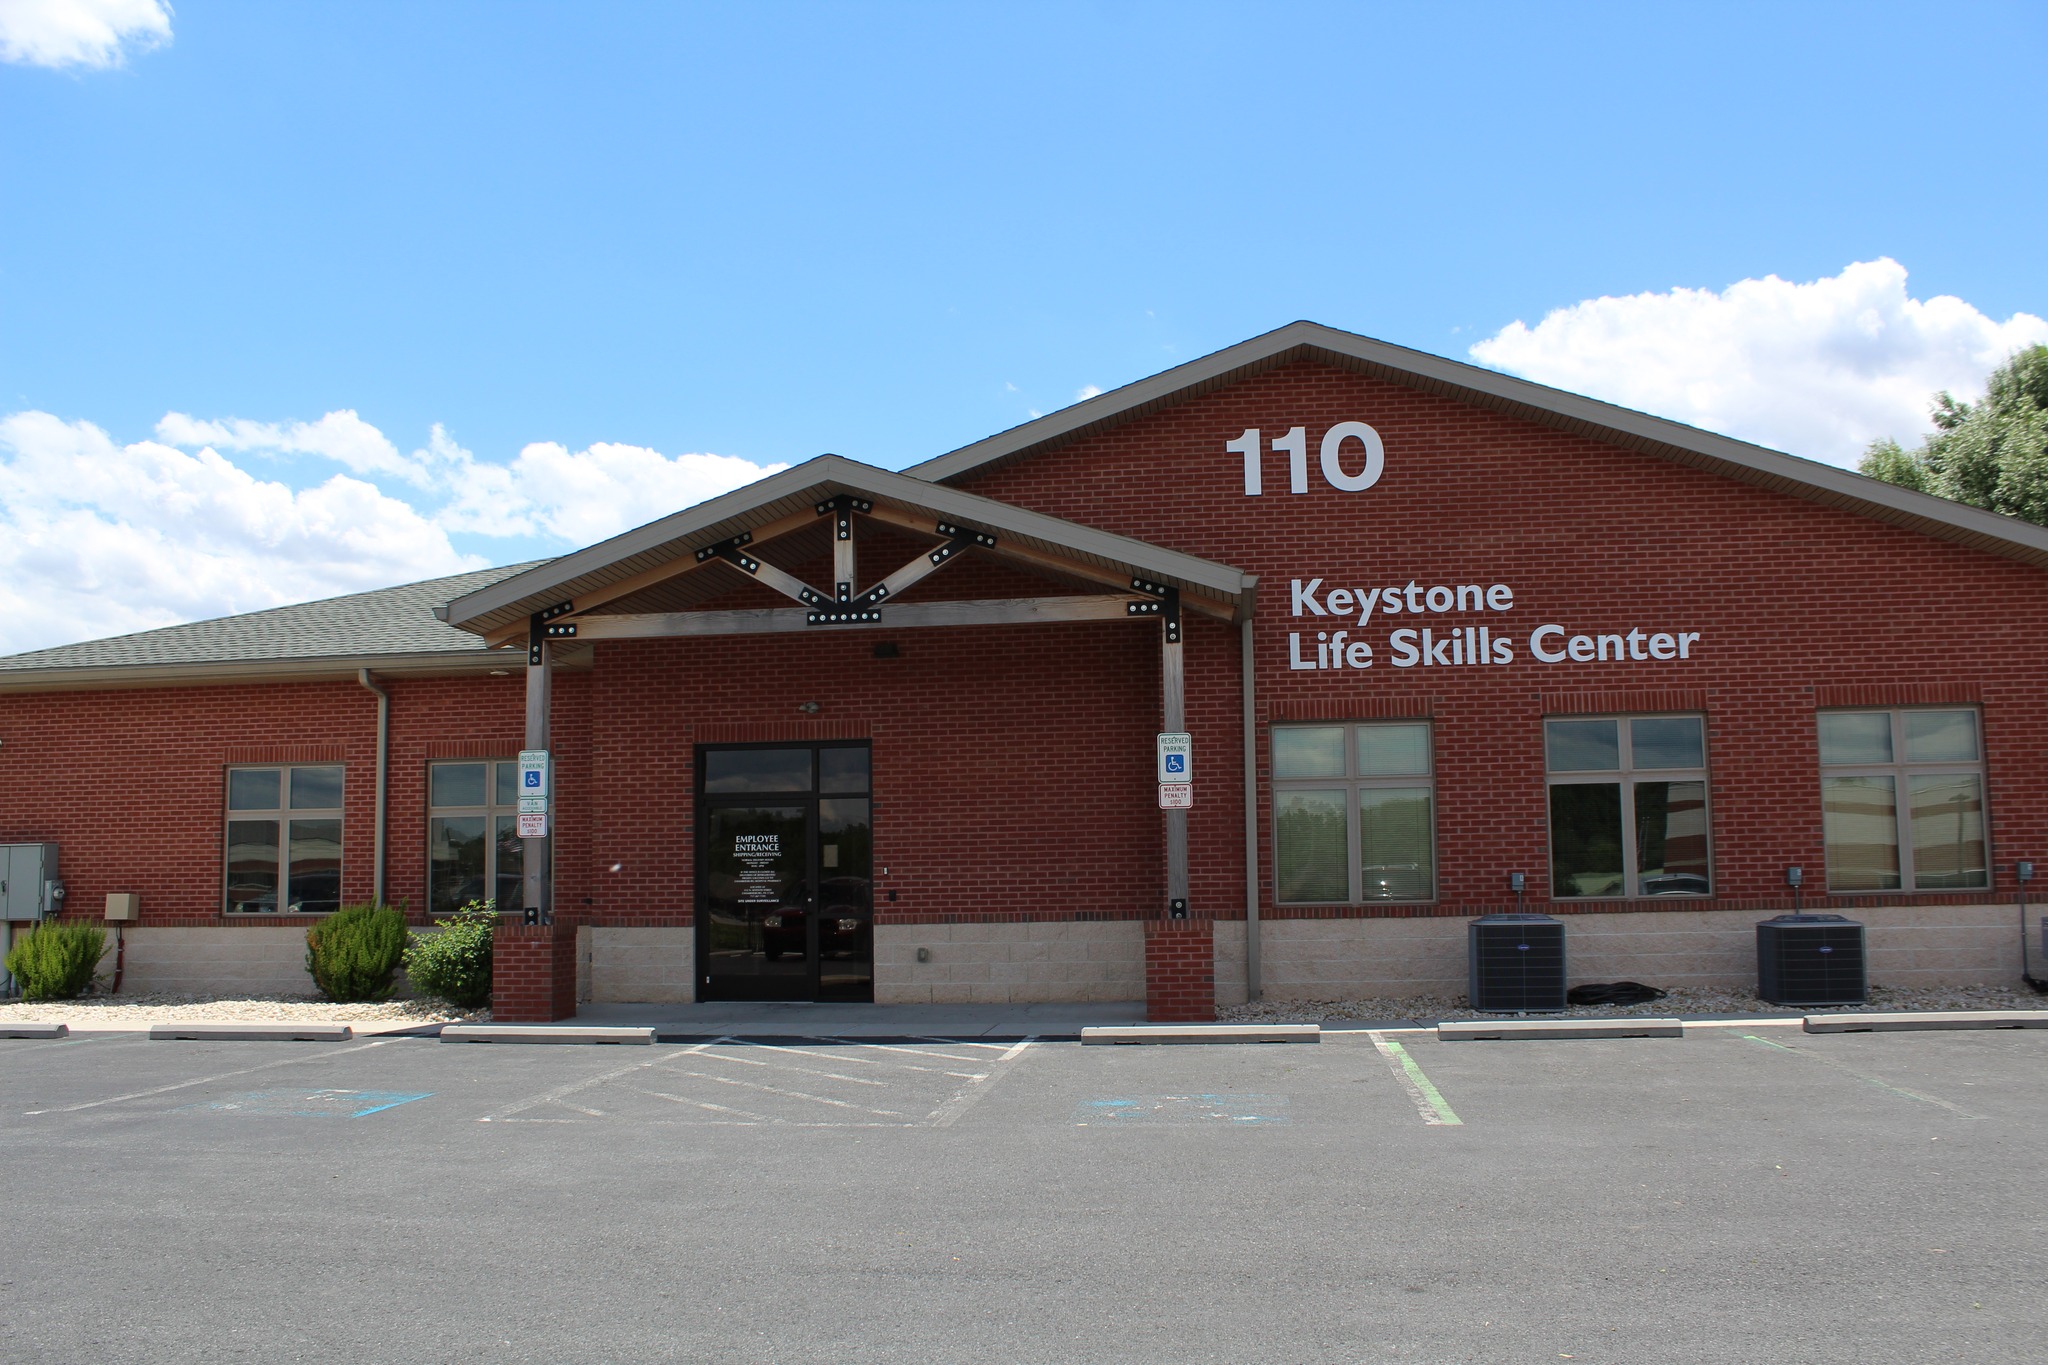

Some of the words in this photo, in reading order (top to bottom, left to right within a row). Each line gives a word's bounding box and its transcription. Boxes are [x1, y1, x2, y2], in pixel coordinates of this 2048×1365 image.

[1226, 420, 1385, 496] 110
[1290, 578, 1514, 627] Keystone
[1289, 630, 1374, 670] Life
[1390, 626, 1514, 668] Skills
[1530, 624, 1701, 664] Center
[735, 843, 779, 851] ENTRANCE
[736, 835, 778, 843] EMPLOYEE
